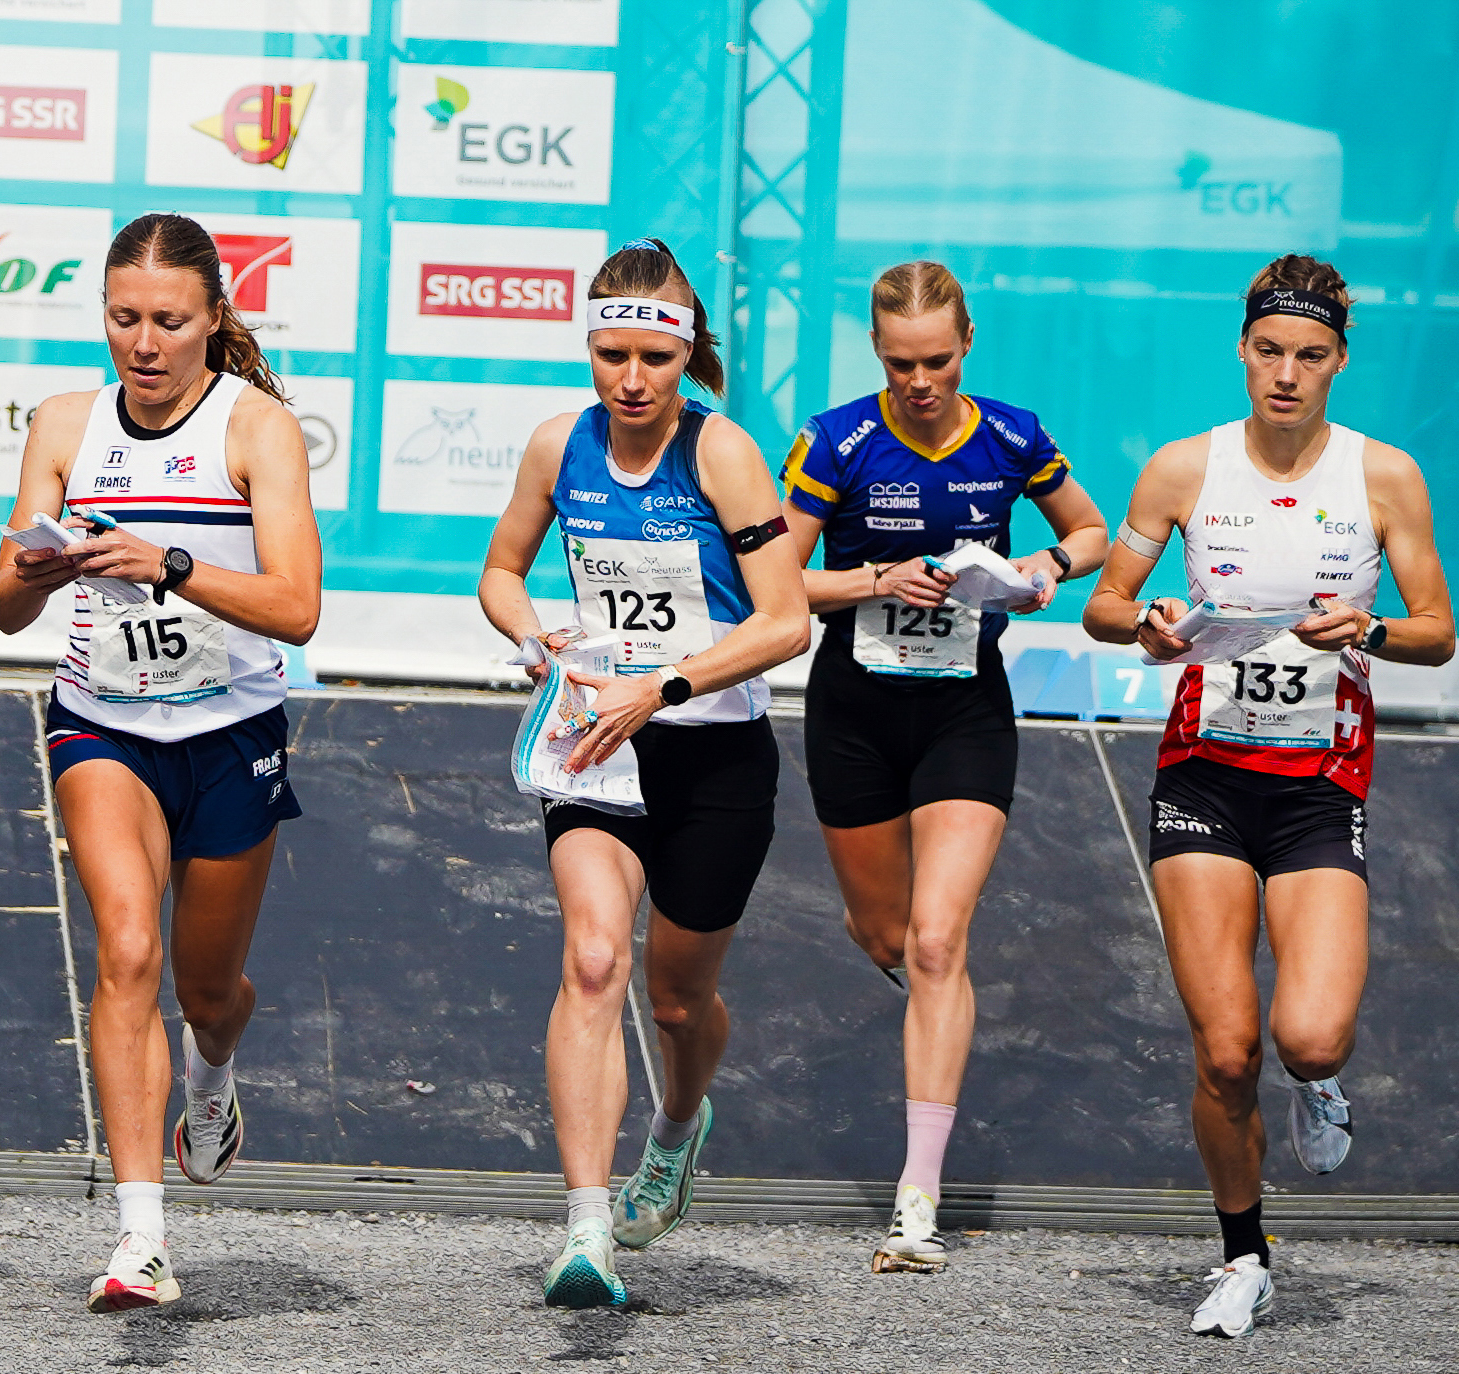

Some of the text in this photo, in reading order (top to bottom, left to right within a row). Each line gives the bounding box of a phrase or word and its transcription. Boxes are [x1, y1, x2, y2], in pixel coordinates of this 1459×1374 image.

[11, 96, 79, 131] SSR
[459, 123, 574, 166] EGK
[1199, 181, 1293, 217] EGK
[425, 273, 568, 311] SRG SSR
[600, 304, 652, 320] CZE
[1279, 299, 1331, 318] neutrass
[838, 419, 878, 456] SILVA
[447, 445, 526, 468] neutr
[94, 476, 132, 488] FRANCE
[948, 480, 1004, 493] bagheera
[569, 489, 609, 504] TRIMTEX
[653, 496, 696, 509] GAPP
[869, 496, 920, 509] EKSJÖHUS
[1205, 514, 1254, 527] INALP
[1324, 521, 1358, 535] EGK
[646, 523, 688, 537] DUKLA
[1320, 554, 1349, 562] KPMG
[583, 558, 628, 577] EGK
[1314, 571, 1354, 581] TRIMTEX
[599, 589, 676, 632] 123
[881, 603, 956, 638] 125
[119, 617, 188, 662] 115
[636, 640, 662, 650] uster
[910, 645, 935, 654] uster
[152, 670, 180, 679] uster
[1231, 660, 1308, 704] 133
[1115, 668, 1144, 704] 7
[1260, 712, 1289, 721] uster
